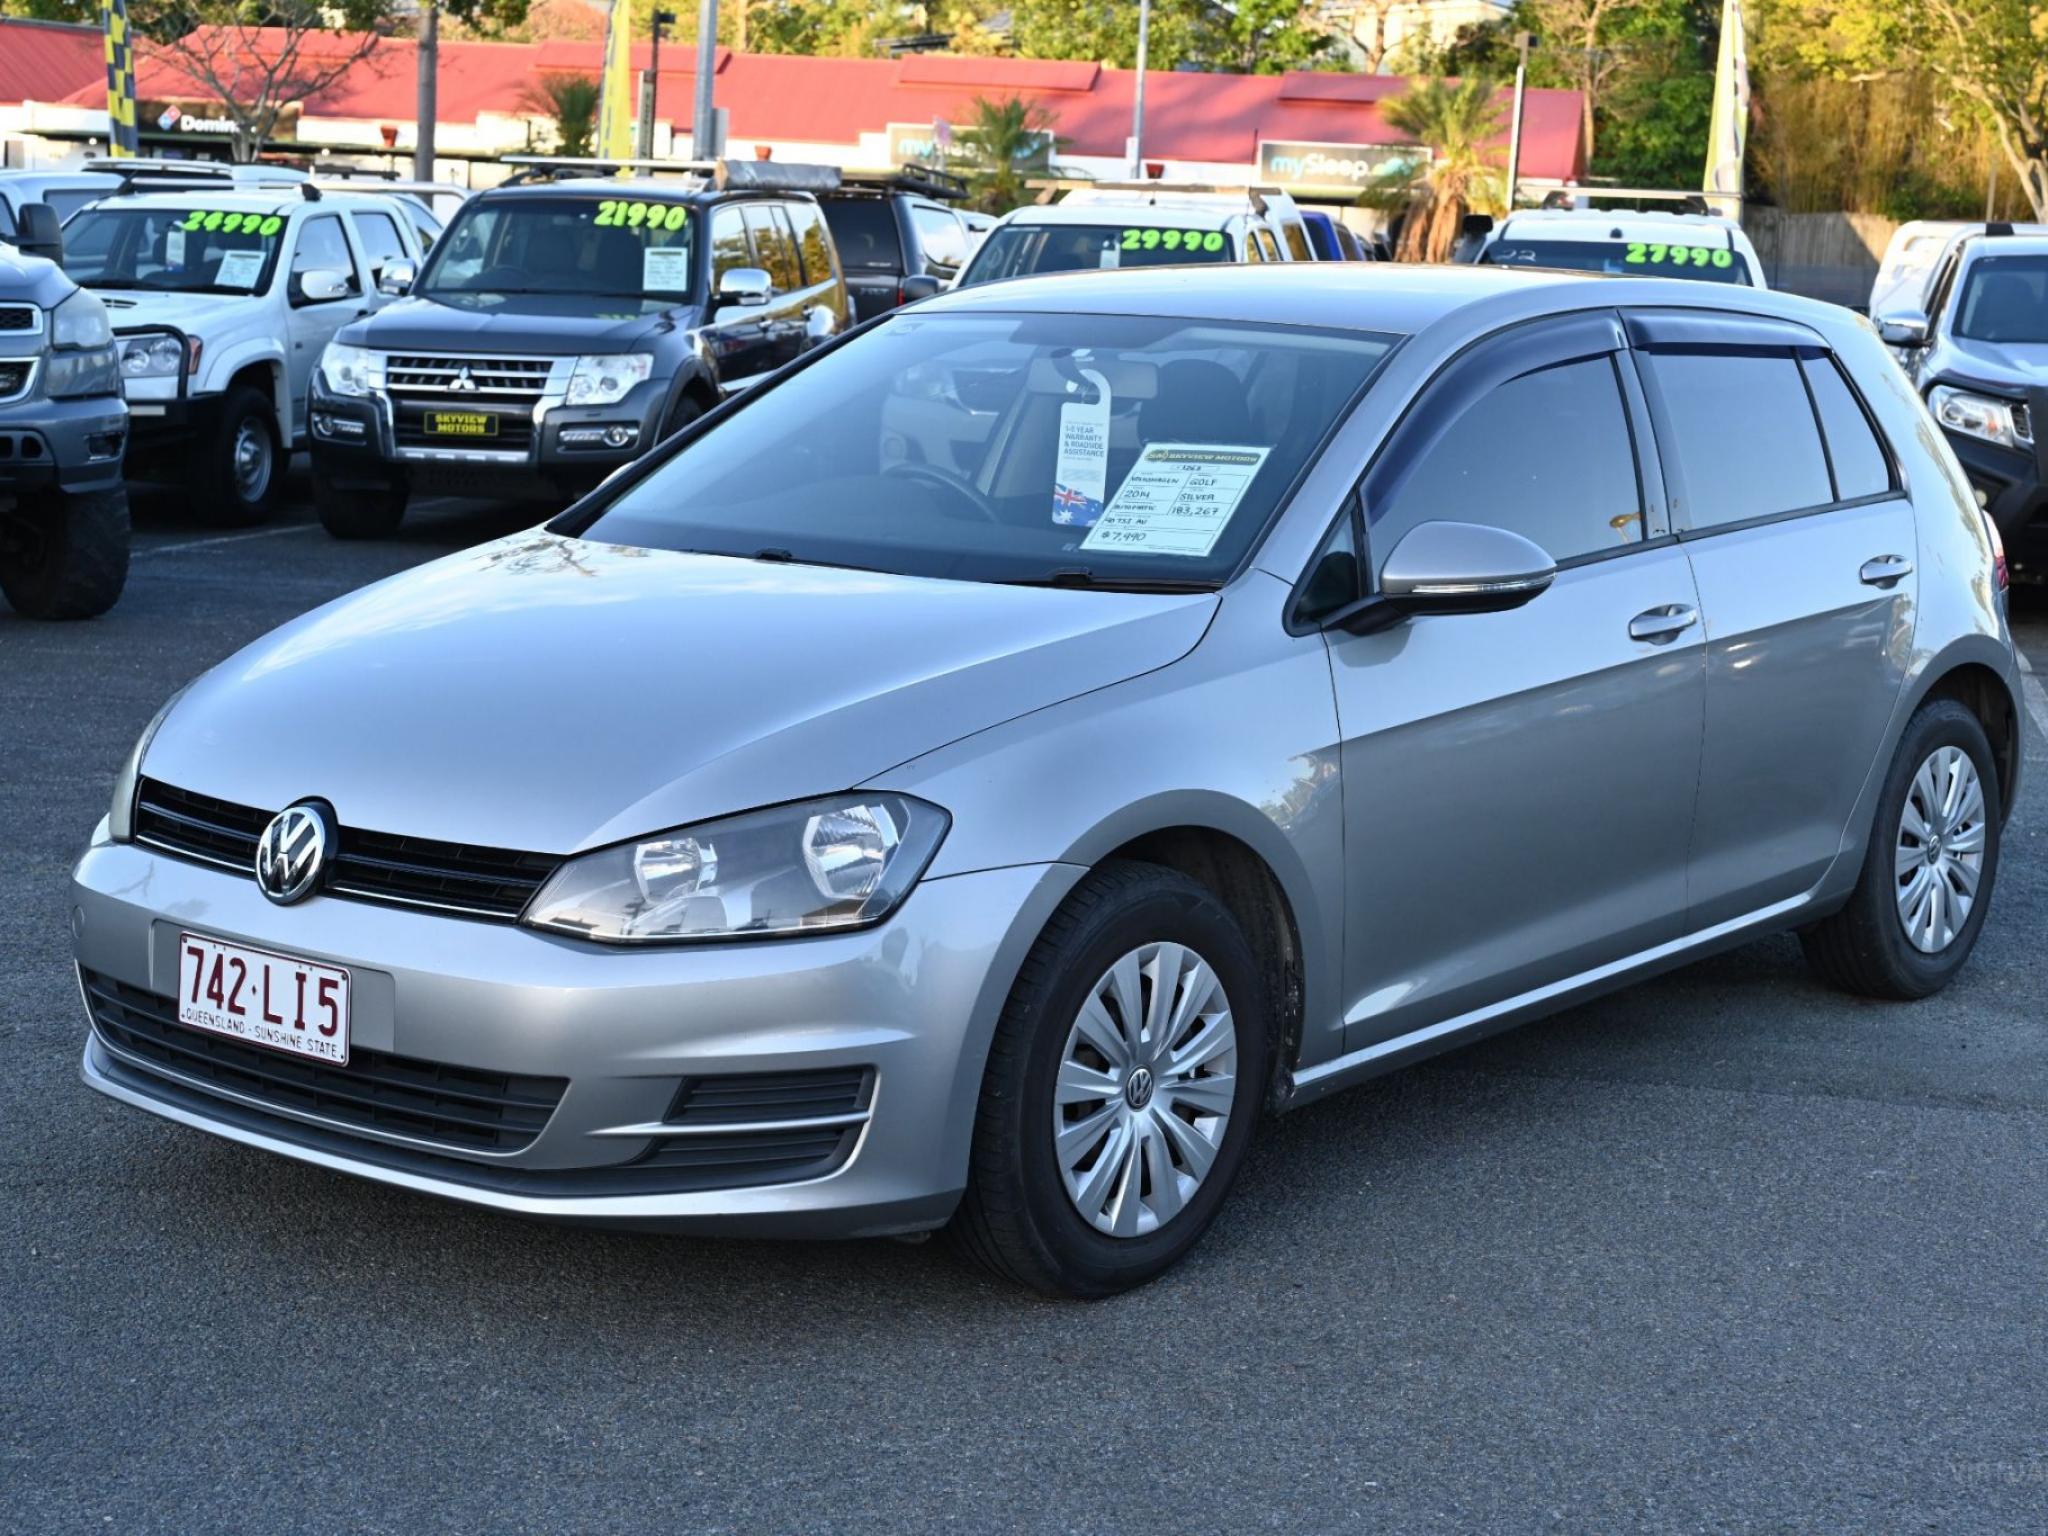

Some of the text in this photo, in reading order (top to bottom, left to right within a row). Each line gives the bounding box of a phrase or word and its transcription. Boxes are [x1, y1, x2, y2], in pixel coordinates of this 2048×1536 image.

[1270, 152, 1369, 181] mySleep
[593, 200, 686, 231] 21990
[183, 211, 281, 235] 24990
[1121, 229, 1223, 251] 29990
[1625, 242, 1733, 268] 27990
[435, 414, 487, 424] SKYVIEW
[437, 423, 485, 433] MOTORS
[1076, 425, 1094, 433] YEAR
[1065, 433, 1102, 441] WARRANTY
[1071, 441, 1104, 449] ROADSIDE
[1064, 449, 1104, 457] ASSISTANCE
[1189, 478, 1217, 486] GOLF
[1123, 490, 1151, 498] 2014
[1179, 493, 1215, 501] SILVER
[1171, 506, 1219, 516] 183,267
[186, 1007, 245, 1034] QUEENSLAND
[255, 1025, 302, 1049] SUNSHINE
[306, 1038, 337, 1058] STATE
